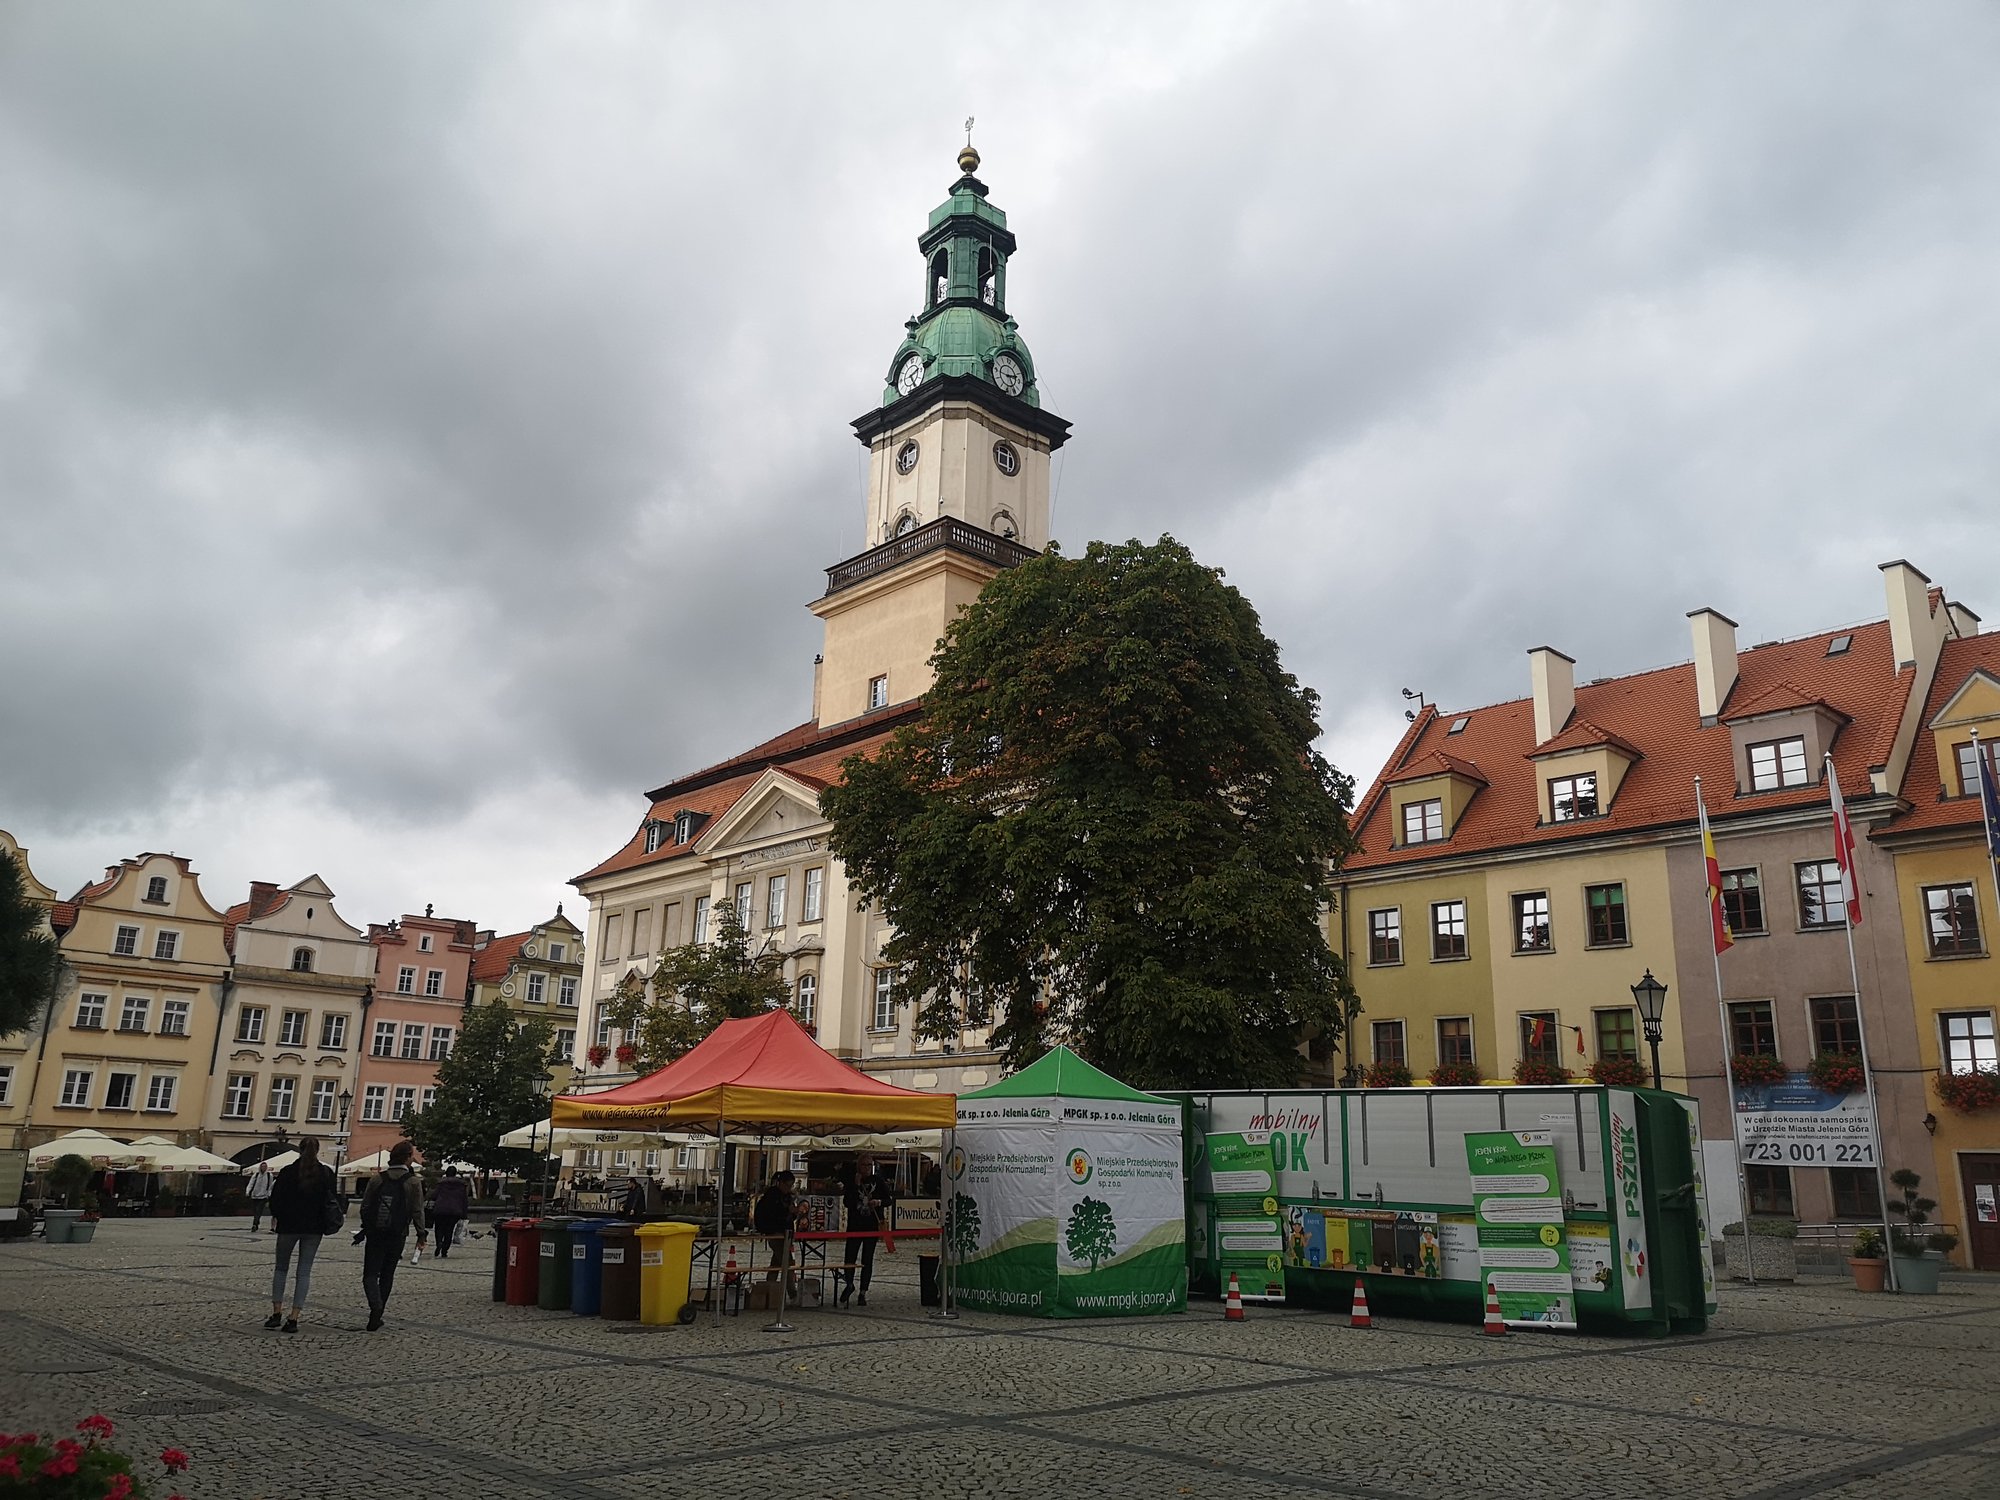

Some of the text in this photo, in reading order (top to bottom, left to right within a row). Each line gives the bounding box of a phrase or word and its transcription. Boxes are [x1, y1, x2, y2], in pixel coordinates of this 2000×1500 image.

[956, 1110, 967, 1119] GK
[968, 1111, 979, 1120] sp.
[1002, 1107, 1029, 1118] Jelenia
[1030, 1107, 1050, 1118] Góra
[1063, 1108, 1088, 1119] MPGK
[1090, 1111, 1103, 1122] sp.
[1111, 1113, 1127, 1121] o.o.
[1128, 1112, 1155, 1123] Jelenia
[1157, 1114, 1176, 1125] Góra
[1754, 1116, 1772, 1124] celu
[1772, 1115, 1819, 1123] dokonania
[1820, 1116, 1868, 1125] samospisu
[1248, 1108, 1320, 1140] mobilny
[1752, 1126, 1787, 1134] Urzędzie
[1788, 1125, 1815, 1133] Miasta
[1848, 1125, 1870, 1133] Góra
[1269, 1131, 1310, 1172] OK
[1612, 1112, 1623, 1180] mobilny
[1745, 1143, 1874, 1162] 723 001 221
[970, 1153, 1054, 1164] Miejskie Przedsiębiorstwo
[1096, 1156, 1179, 1169] Miejskie Przedsiębiorstwo
[969, 1164, 1047, 1175] Gospodarki Komunalnej
[1097, 1168, 1174, 1180] Gospodarki Komunalnej
[1620, 1125, 1640, 1217] PSZOK
[896, 1206, 940, 1221] Piwniczka
[1075, 1288, 1176, 1310] www.mpgk.jgora.pl
